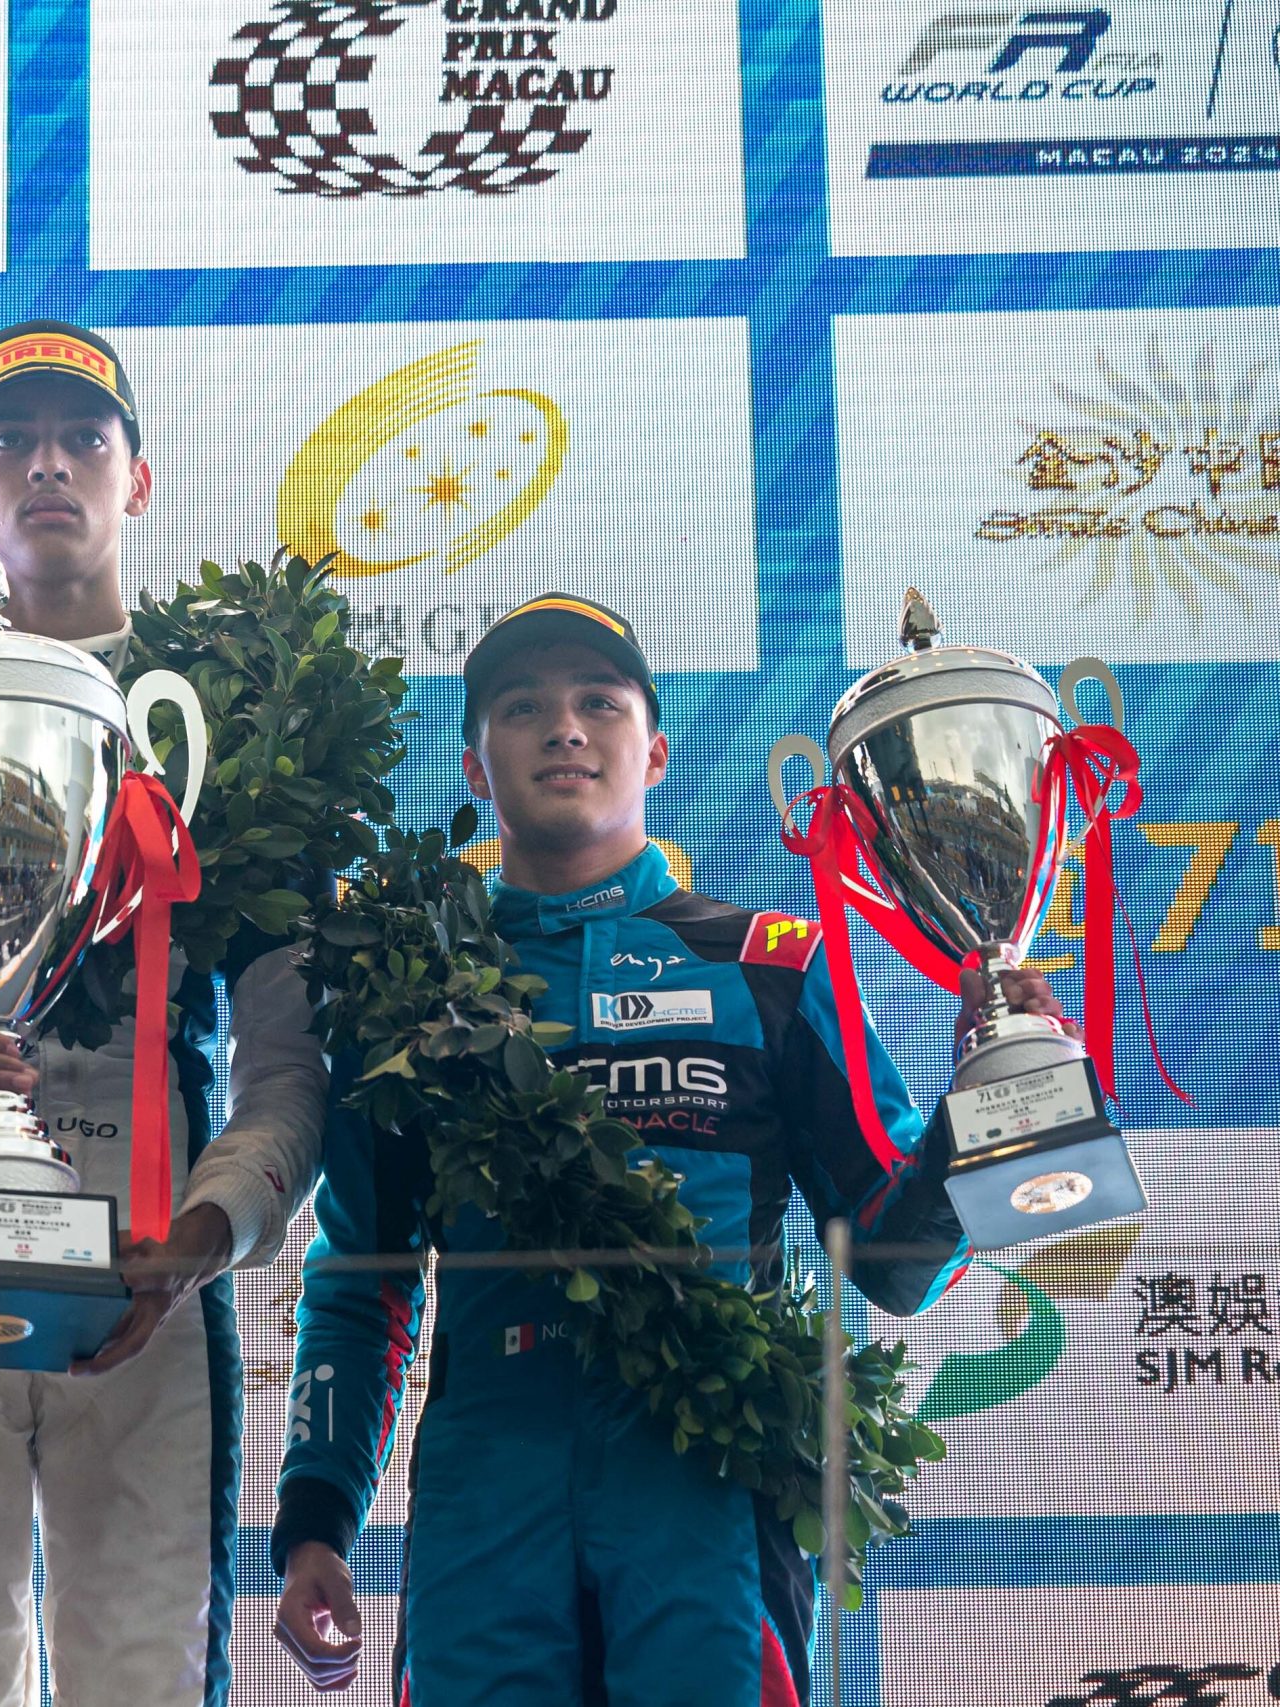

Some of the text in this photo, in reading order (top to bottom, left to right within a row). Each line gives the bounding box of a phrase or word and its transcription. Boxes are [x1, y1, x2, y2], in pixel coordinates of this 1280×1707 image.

[442, 30, 556, 61] PRIX
[441, 68, 614, 102] MACAU
[881, 78, 1157, 102] WORLD CUP
[1039, 146, 1278, 167] MACAU 2024
[565, 885, 625, 912] KCMG
[765, 919, 808, 952] P1
[600, 1019, 624, 1028] DRIVER
[625, 1018, 674, 1028] DEVELOPMENT
[653, 1007, 707, 1016] KCMG
[566, 1056, 727, 1094] CMG
[57, 1117, 118, 1138] UGO
[1134, 1271, 1280, 1337] 澳娛
[1135, 1347, 1221, 1393] SJM
